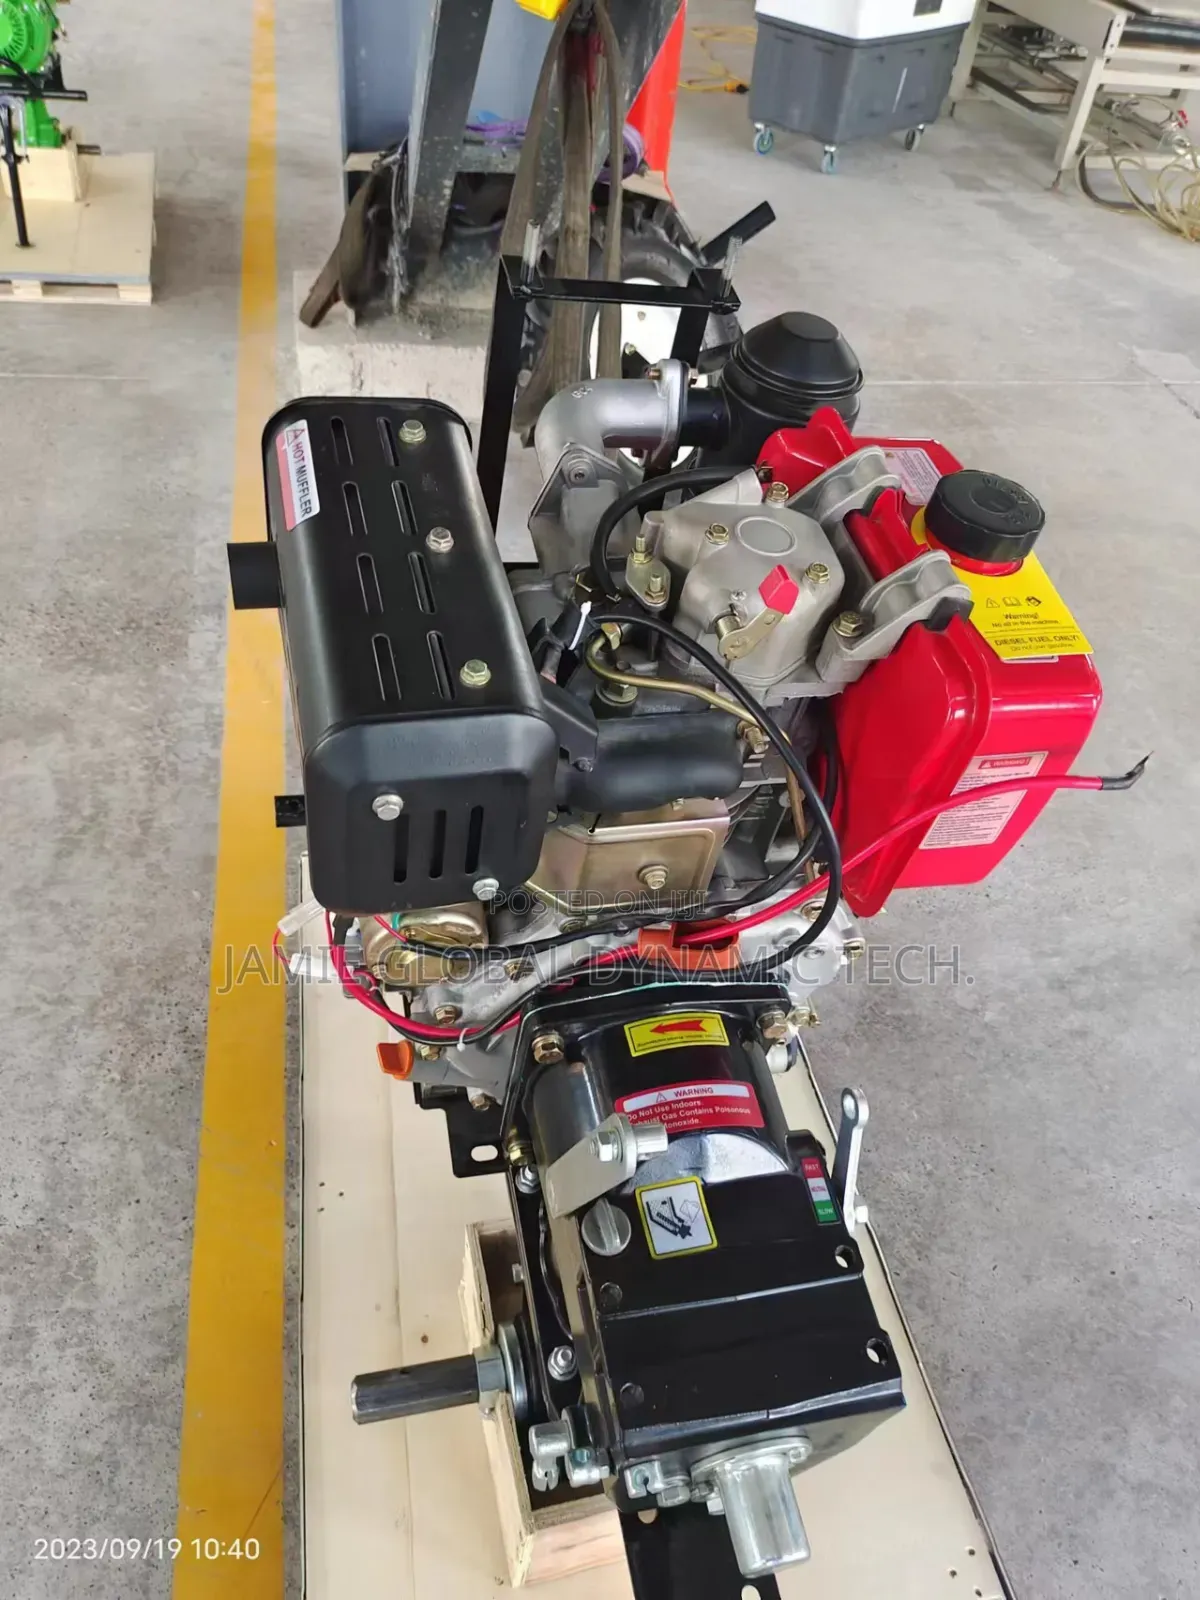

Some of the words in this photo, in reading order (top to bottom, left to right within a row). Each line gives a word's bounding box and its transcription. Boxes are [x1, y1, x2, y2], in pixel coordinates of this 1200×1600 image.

[293, 442, 305, 463] HOT
[296, 464, 313, 517] MUFFLER
[995, 637, 1027, 646] DIESEL
[1027, 635, 1053, 643] FUEL
[674, 1087, 714, 1098] WARNING
[639, 1109, 653, 1118] Not
[654, 1105, 670, 1113] Use
[671, 1100, 704, 1110] Indoors.
[679, 1107, 713, 1117] Contains
[714, 1106, 751, 1114] Poisonous
[805, 1163, 819, 1171] FAST
